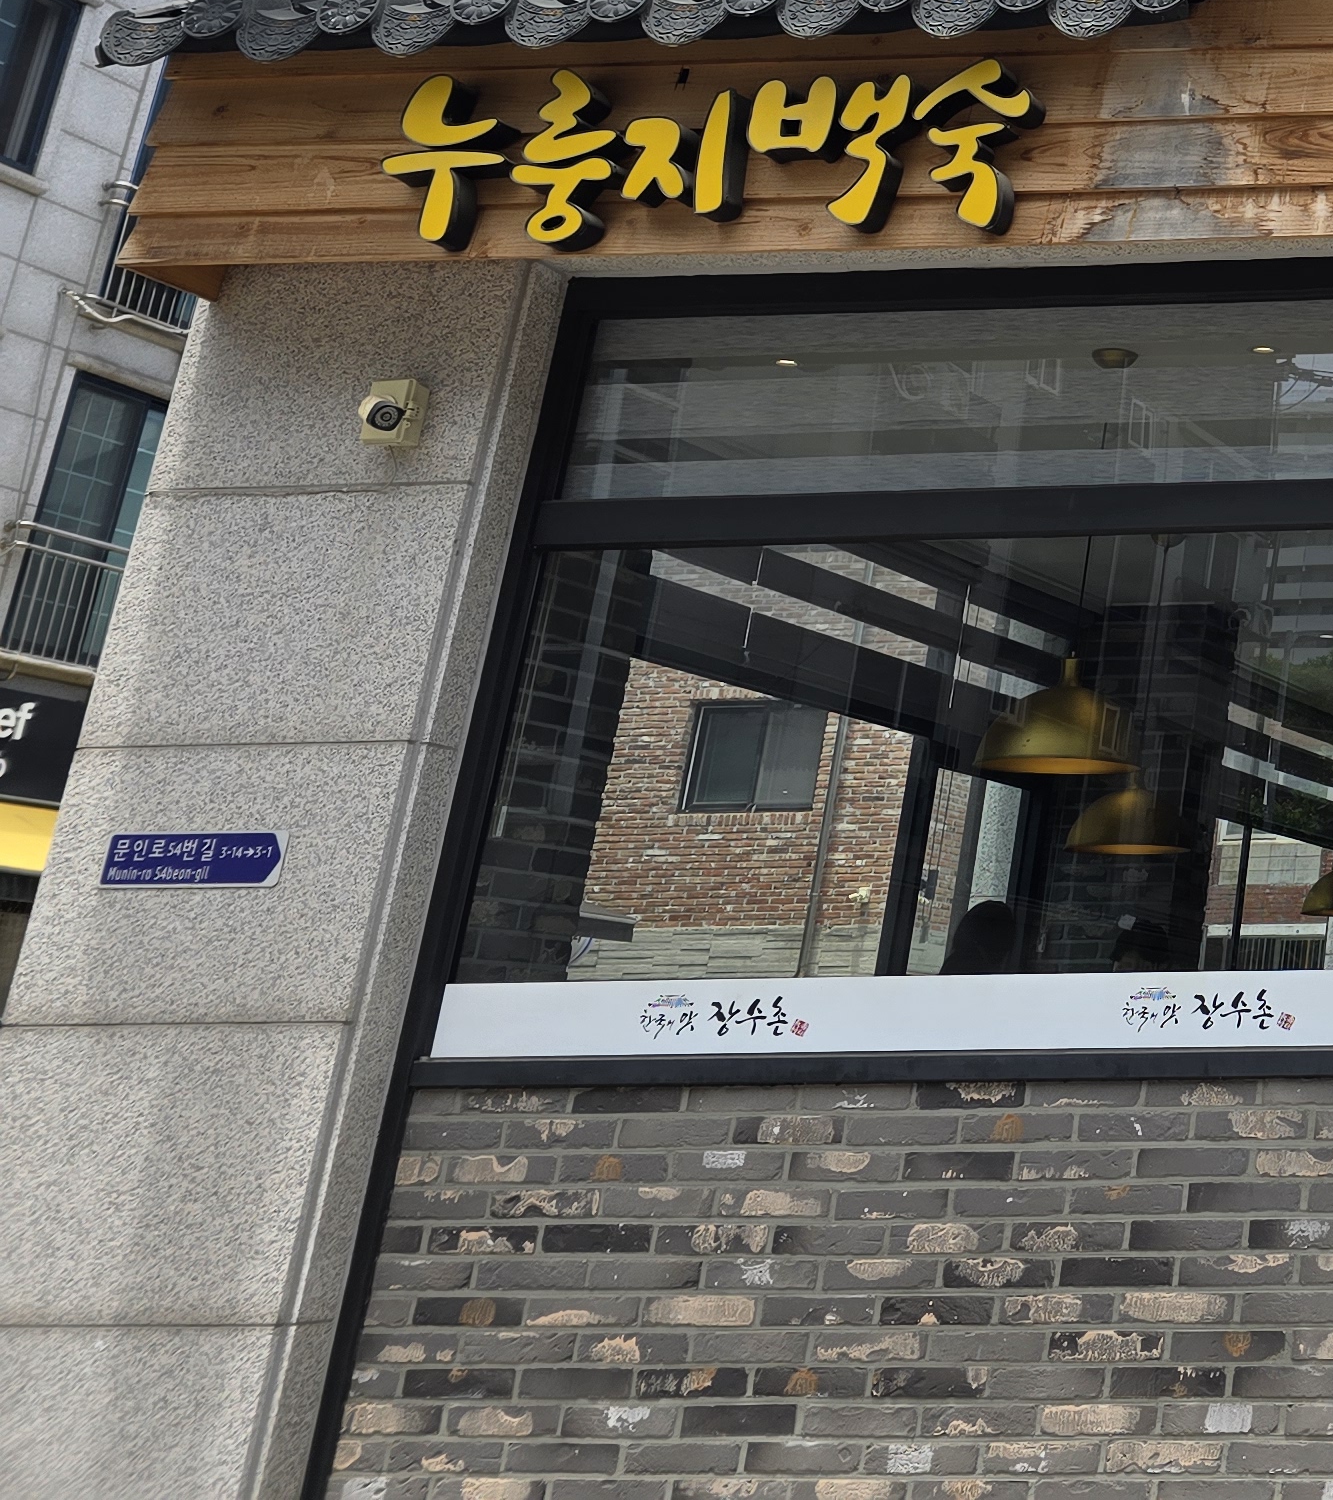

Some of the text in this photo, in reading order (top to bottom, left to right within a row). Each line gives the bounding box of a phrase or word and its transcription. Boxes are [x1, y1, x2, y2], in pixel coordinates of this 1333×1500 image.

[381, 58, 1042, 249] 누룽지백숙
[113, 838, 217, 861] 문인로54번길
[106, 865, 209, 882] Munin-ro 54beon-gil
[676, 1010, 699, 1035] 맛
[706, 995, 789, 1036] 장수촌
[1159, 1003, 1182, 1028] 맛
[1190, 988, 1274, 1030] 장수촌
